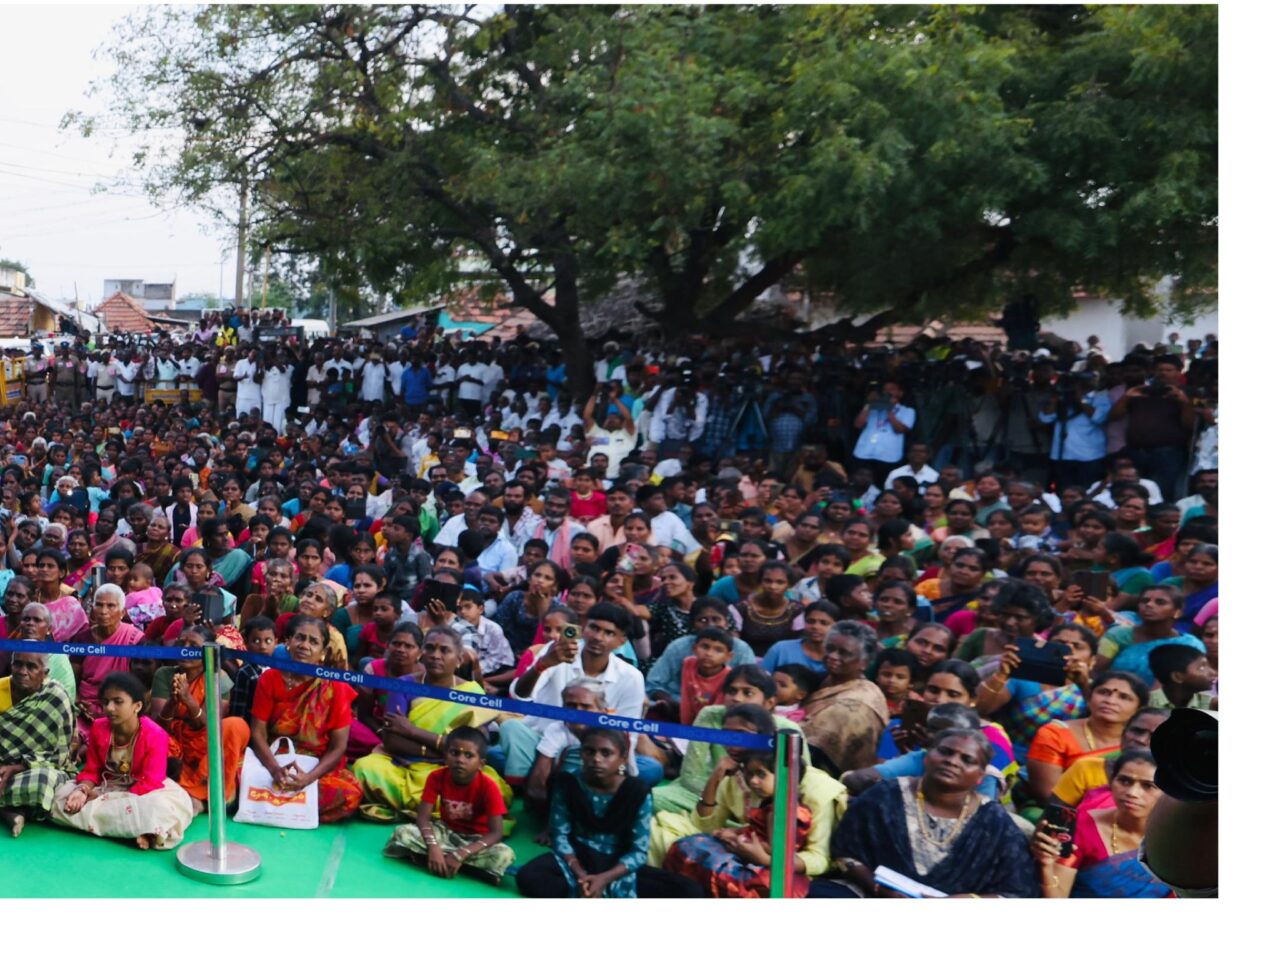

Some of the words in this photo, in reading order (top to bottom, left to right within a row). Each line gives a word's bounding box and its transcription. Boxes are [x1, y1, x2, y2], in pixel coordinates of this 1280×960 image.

[63, 645, 86, 654] Core
[87, 645, 105, 654] Cell
[316, 668, 340, 679] Core
[343, 671, 363, 683] Cell
[449, 691, 476, 703] Core
[479, 696, 502, 708] Cell
[599, 715, 630, 727] Core
[633, 720, 659, 733] Cell
